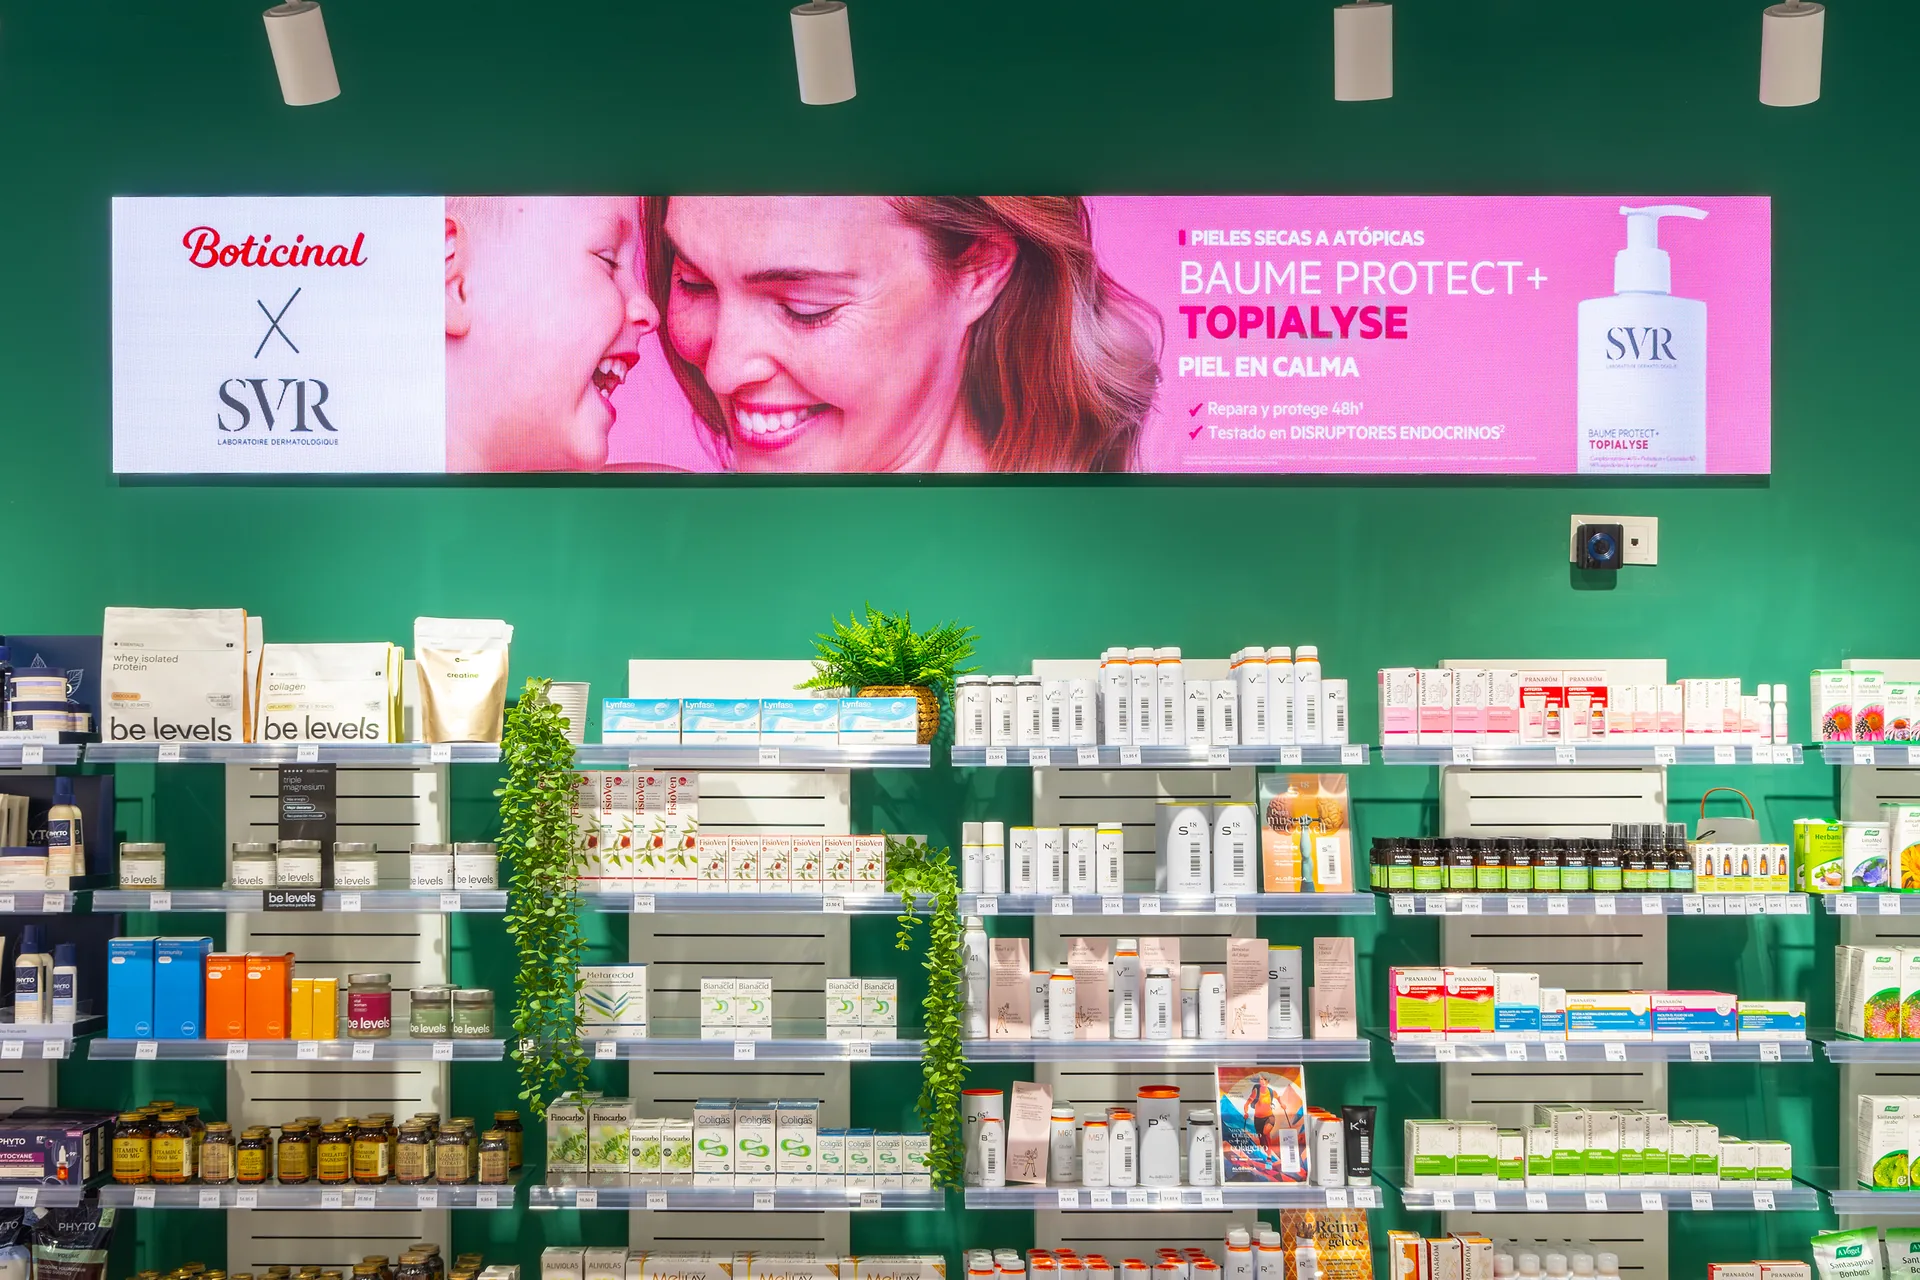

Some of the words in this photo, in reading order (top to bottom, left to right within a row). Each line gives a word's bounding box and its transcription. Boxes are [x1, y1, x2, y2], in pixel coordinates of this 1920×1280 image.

[1192, 230, 1251, 246] PIELES
[1254, 230, 1312, 246] SECAS
[1315, 230, 1329, 246] A
[1333, 226, 1424, 246] ATÓPICAS
[182, 226, 368, 268] Boticinal
[1180, 260, 1321, 295] BAUME
[1336, 260, 1548, 295] PROTECT+
[1179, 305, 1408, 339] TOPIALYSE
[1606, 327, 1677, 360] SVR
[1178, 356, 1230, 378] PIEL
[1235, 356, 1268, 378] EN
[1272, 356, 1360, 378] CALMA
[218, 378, 338, 432] SVR
[1208, 402, 1257, 418] Repara
[1260, 405, 1270, 418] y
[1273, 403, 1328, 418] protege
[1208, 426, 1266, 440] Testado
[1270, 429, 1286, 440] en
[1290, 425, 1396, 440] DISRUPTORES
[1588, 428, 1616, 438] BAUME
[1589, 440, 1649, 450] TOPIALYSE
[114, 654, 139, 664] whey
[142, 654, 178, 663] isolated
[113, 663, 147, 671] protein
[269, 682, 306, 692] collagen
[606, 701, 636, 711] Lynfase
[685, 701, 715, 711] Lynfase
[764, 701, 794, 711] Lynfase
[842, 700, 872, 710] Lynfase
[110, 716, 146, 740] be
[153, 717, 232, 742] levels
[264, 716, 298, 740] be
[305, 715, 380, 740] levels
[283, 776, 302, 784] triple
[283, 784, 325, 792] magnesium
[604, 776, 612, 816] FisioVen
[636, 776, 645, 816] FisioVen
[668, 776, 677, 816] FisioVen
[131, 875, 157, 884] levels
[288, 873, 314, 882] levels
[345, 876, 370, 885] levels
[468, 874, 493, 884] levels
[269, 892, 284, 902] be
[286, 892, 316, 902] levels
[360, 1017, 390, 1029] levels
[420, 1025, 446, 1033] levels
[454, 1025, 462, 1033] be
[464, 1024, 490, 1034] levels
[551, 1114, 584, 1122] Finocarbo
[593, 1114, 626, 1122] Finocarbo
[699, 1115, 730, 1126] Coligas
[740, 1115, 771, 1125] Coligas
[781, 1115, 812, 1125] Coligas
[820, 1140, 842, 1149] Coligas
[848, 1140, 871, 1149] Coligas
[877, 1140, 900, 1149] Coligas
[905, 1140, 927, 1148] Coligas
[59, 1222, 96, 1231] PHYTO
[1316, 1220, 1359, 1233] Reina
[1830, 1258, 1874, 1269] Santasapina
[1840, 1269, 1870, 1278] Bonbons
